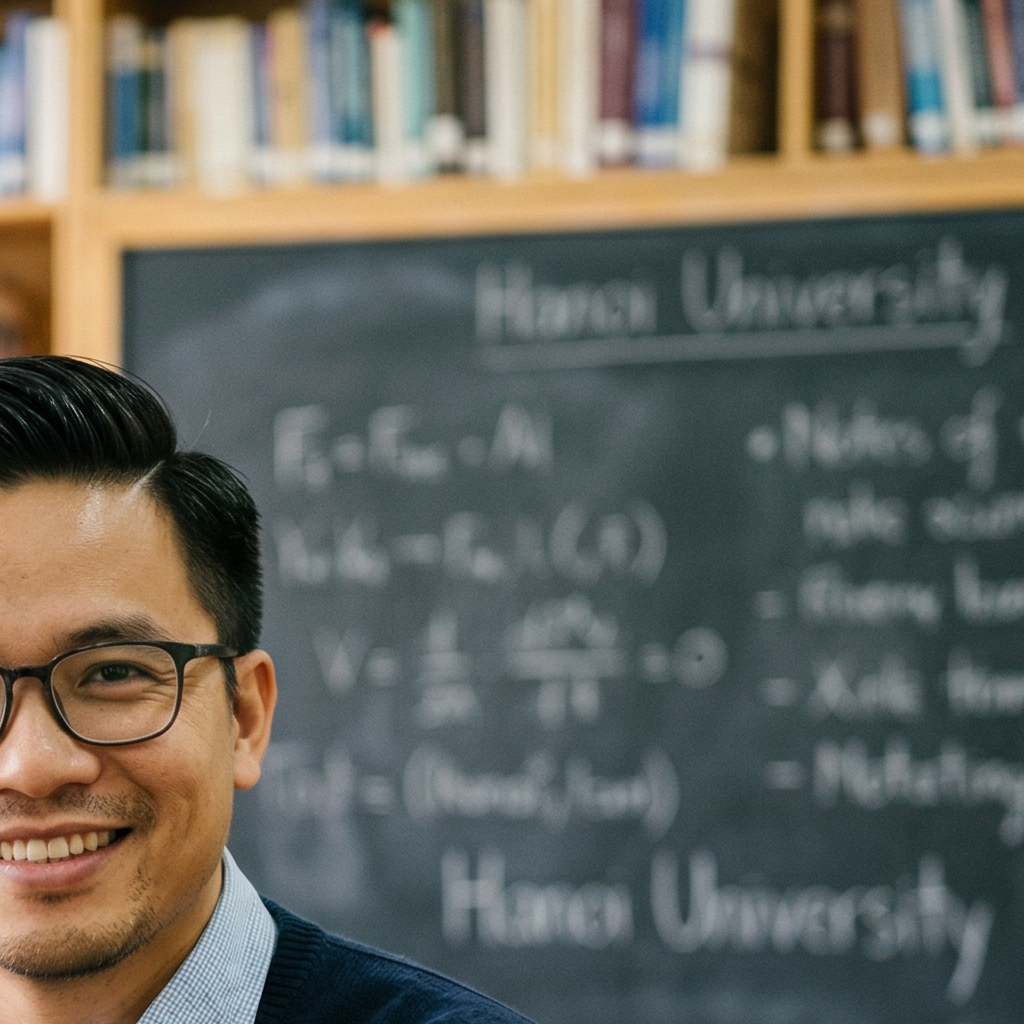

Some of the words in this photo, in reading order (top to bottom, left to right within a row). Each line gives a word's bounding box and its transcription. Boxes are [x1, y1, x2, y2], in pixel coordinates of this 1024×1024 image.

[476, 260, 656, 340] Hanoi
[680, 240, 1008, 366] University
[442, 847, 633, 945] Hanoi
[651, 847, 993, 1003] University
